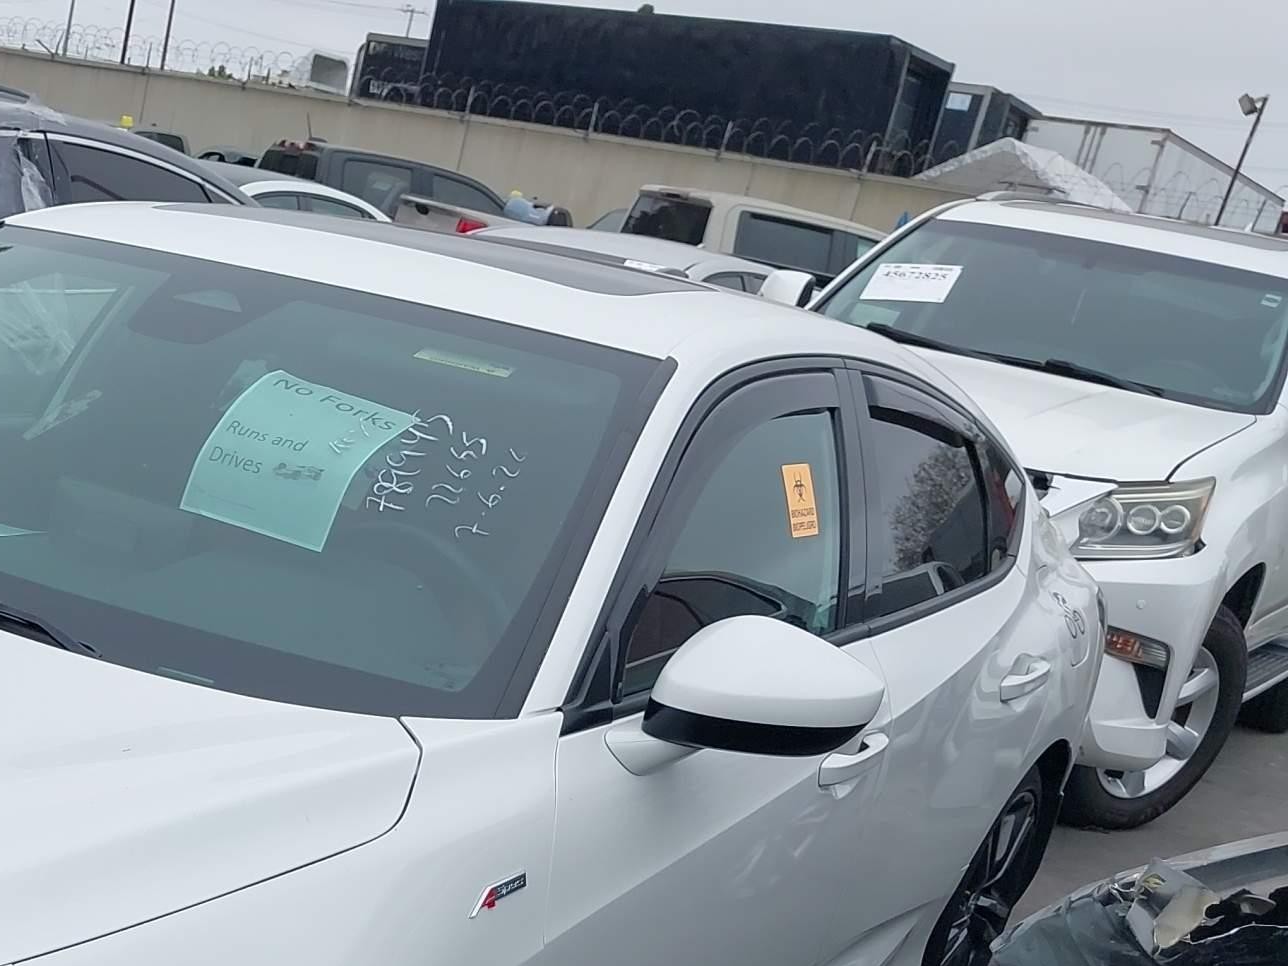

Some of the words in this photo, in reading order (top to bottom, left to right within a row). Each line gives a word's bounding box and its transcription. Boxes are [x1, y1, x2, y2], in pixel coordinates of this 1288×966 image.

[319, 395, 396, 432] Forks
[226, 419, 268, 443] Runs
[271, 434, 308, 453] and
[208, 446, 262, 475] Drives
